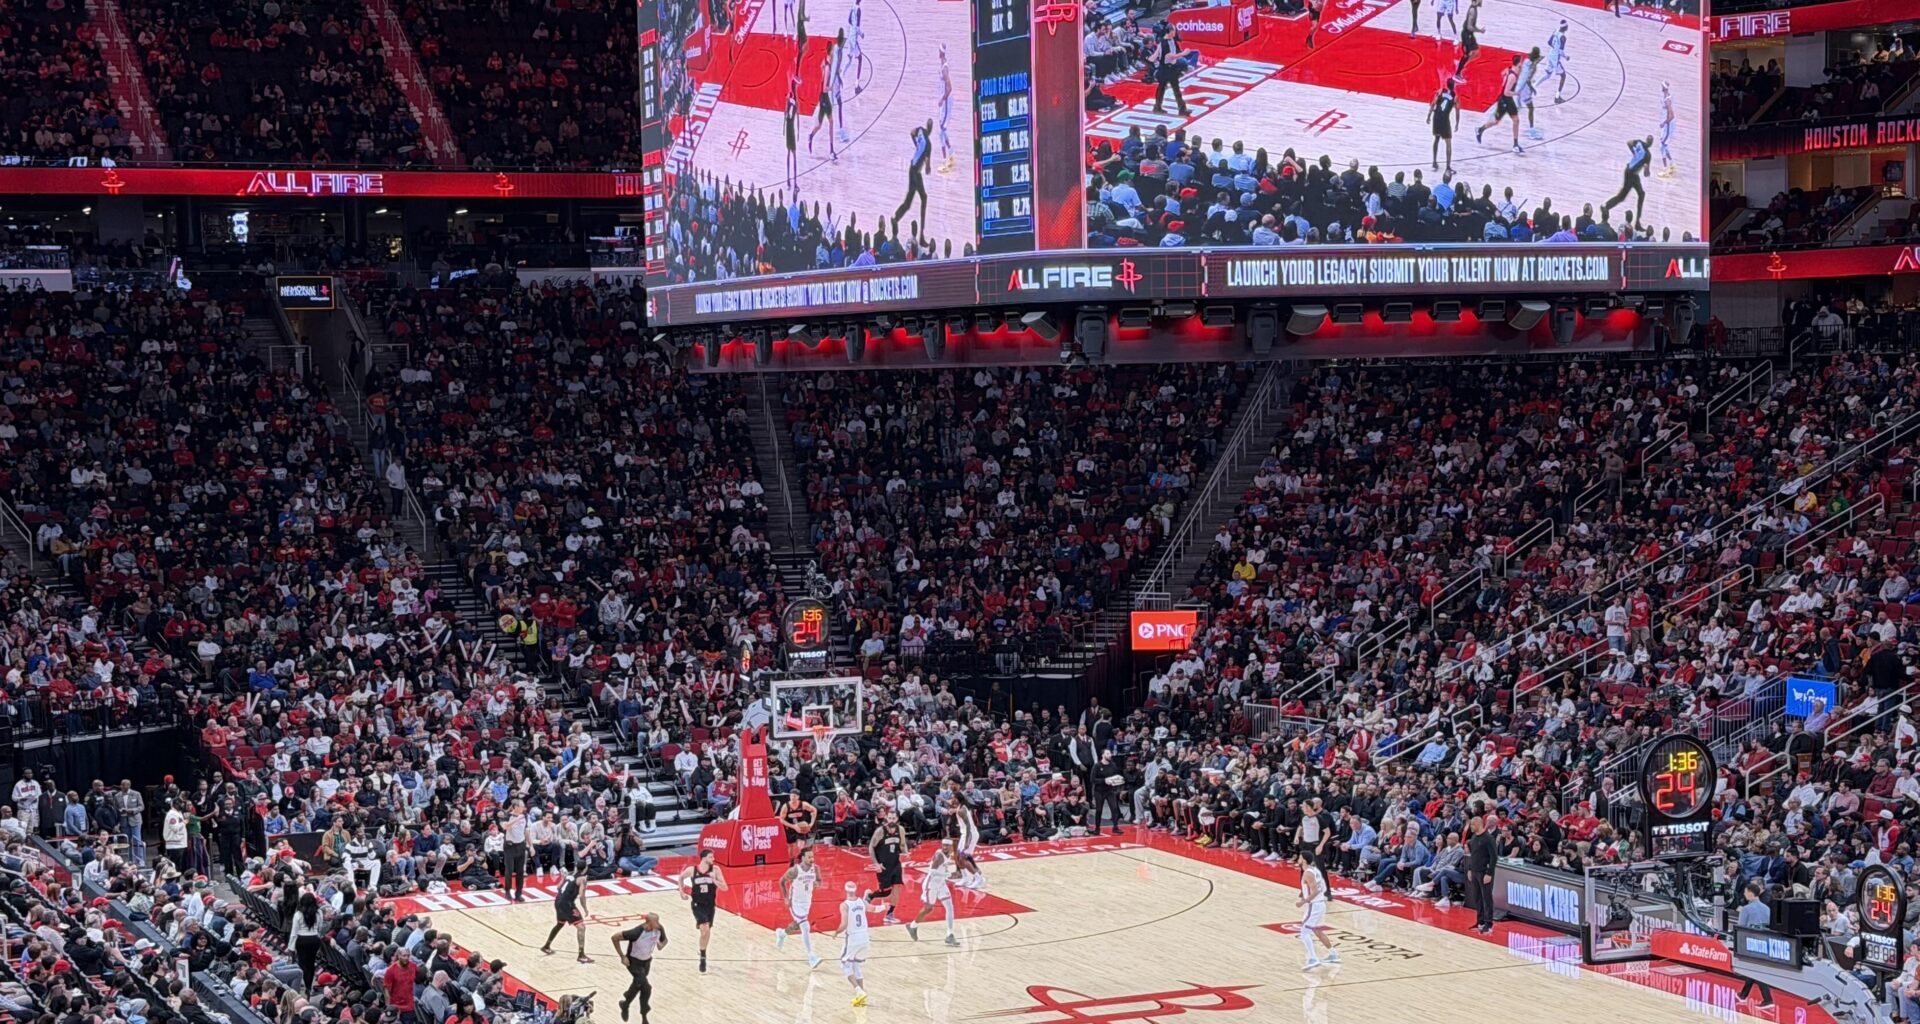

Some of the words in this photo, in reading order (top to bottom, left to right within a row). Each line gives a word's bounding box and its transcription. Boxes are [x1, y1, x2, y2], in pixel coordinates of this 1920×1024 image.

[1176, 20, 1224, 31] coinbase
[1720, 11, 1791, 38] FIRE
[998, 72, 1027, 94] FACTORS
[1804, 122, 1868, 150] HOUSTON
[247, 172, 308, 193] ALL
[311, 173, 384, 194] FIRE
[1007, 268, 1040, 292] ALL
[1042, 265, 1113, 288] FIRE
[1227, 259, 1278, 287] LAUNCH
[1280, 258, 1315, 286] YOUR
[1315, 257, 1367, 286] LEGACY!
[1369, 257, 1415, 284] SUBMIT
[1418, 257, 1449, 283] YOUR
[1451, 256, 1492, 283] TALENT
[1494, 256, 1519, 282] NOW
[1521, 256, 1537, 281] AT
[1537, 255, 1608, 282] ROCKETS.COM
[869, 275, 918, 302] ROCKETS.COM
[793, 621, 821, 644] 24
[799, 651, 827, 659] TISSOT
[1669, 751, 1697, 771] 1:36
[1656, 771, 1696, 811] 24
[753, 825, 779, 837] League
[1668, 821, 1710, 835] TISSOT
[754, 838, 772, 849] Pass
[1507, 881, 1543, 912] HONOR
[1544, 883, 1580, 926] KING
[1876, 884, 1897, 902] 1:36
[856, 914, 862, 927] 9
[1870, 899, 1892, 924] 24
[1327, 930, 1425, 961] TOYOTA
[1768, 938, 1791, 961] KING
